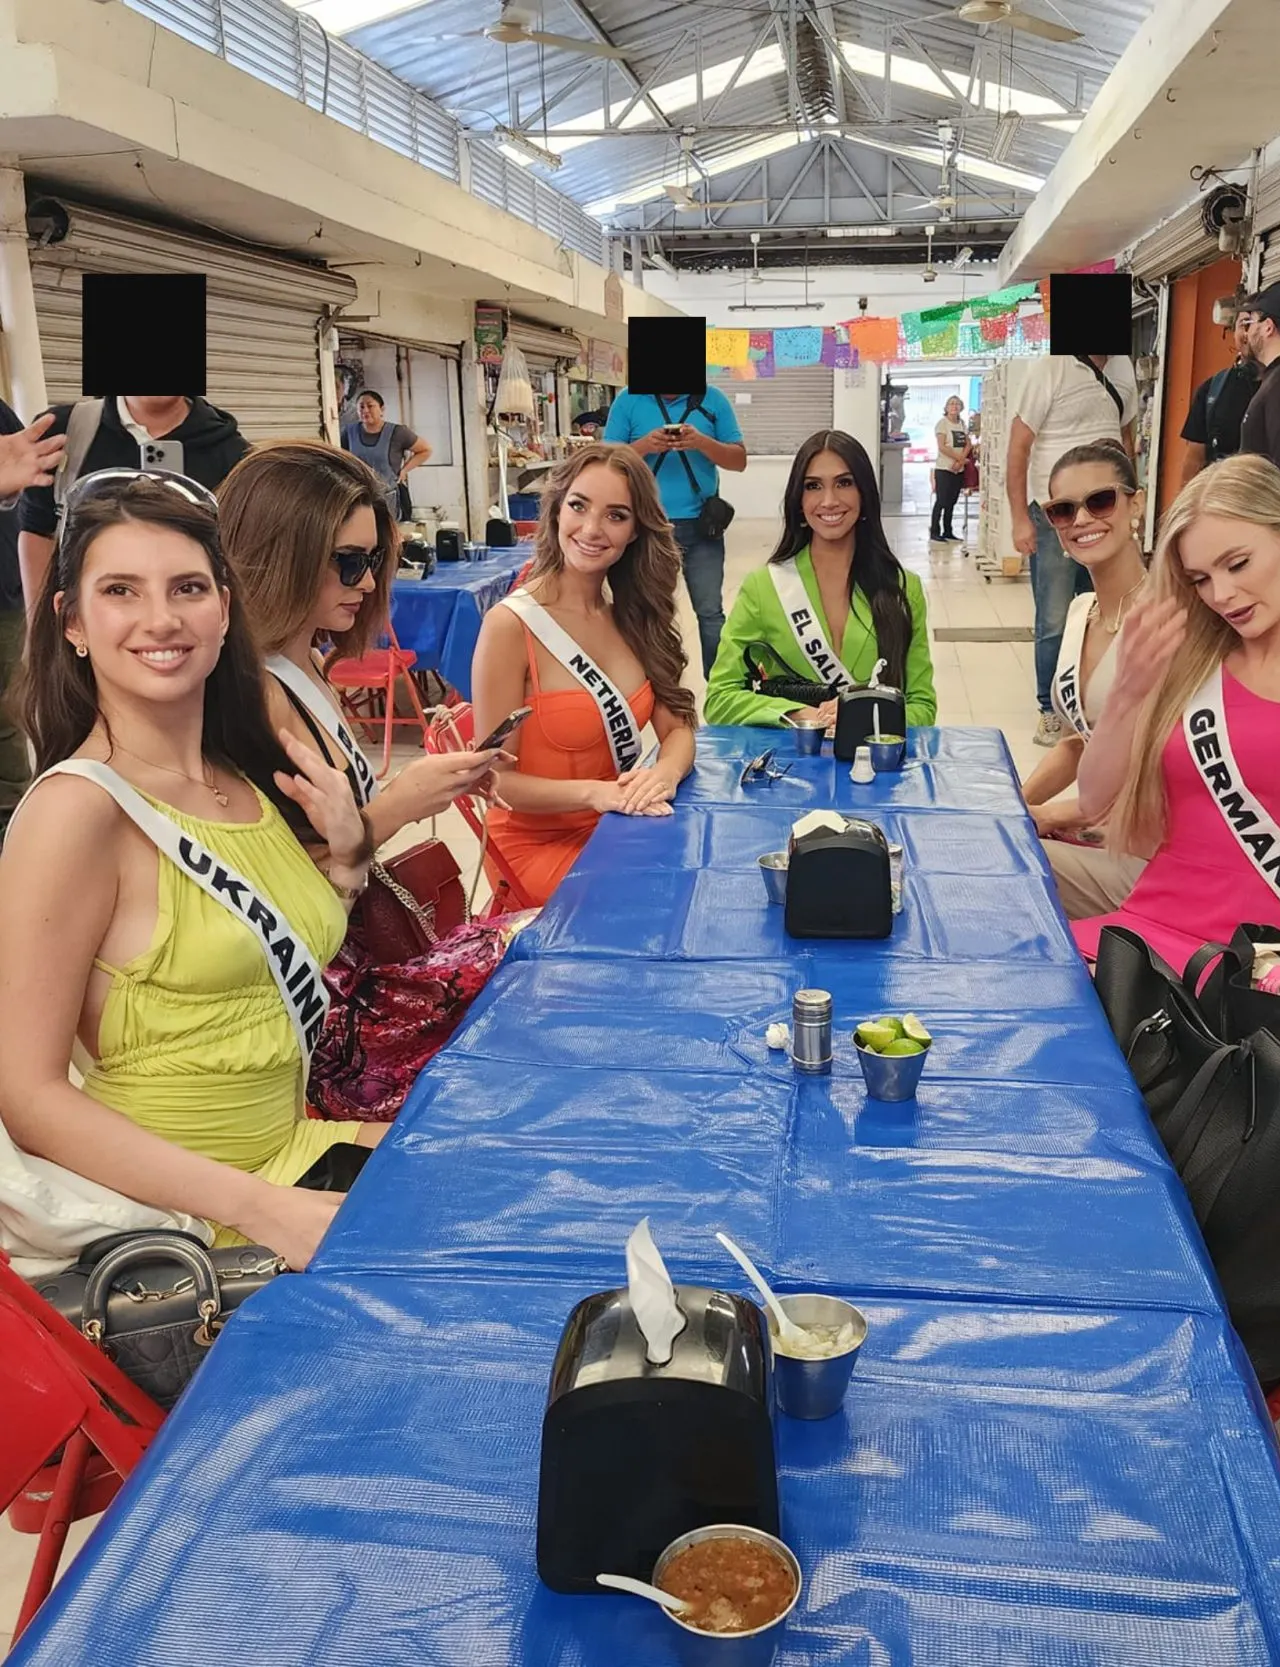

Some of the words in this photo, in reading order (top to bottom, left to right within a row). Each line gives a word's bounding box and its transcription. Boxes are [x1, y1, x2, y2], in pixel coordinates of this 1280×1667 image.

[791, 608, 811, 636] EL
[805, 638, 852, 689] SALV
[178, 836, 325, 1054] UKRAINE
